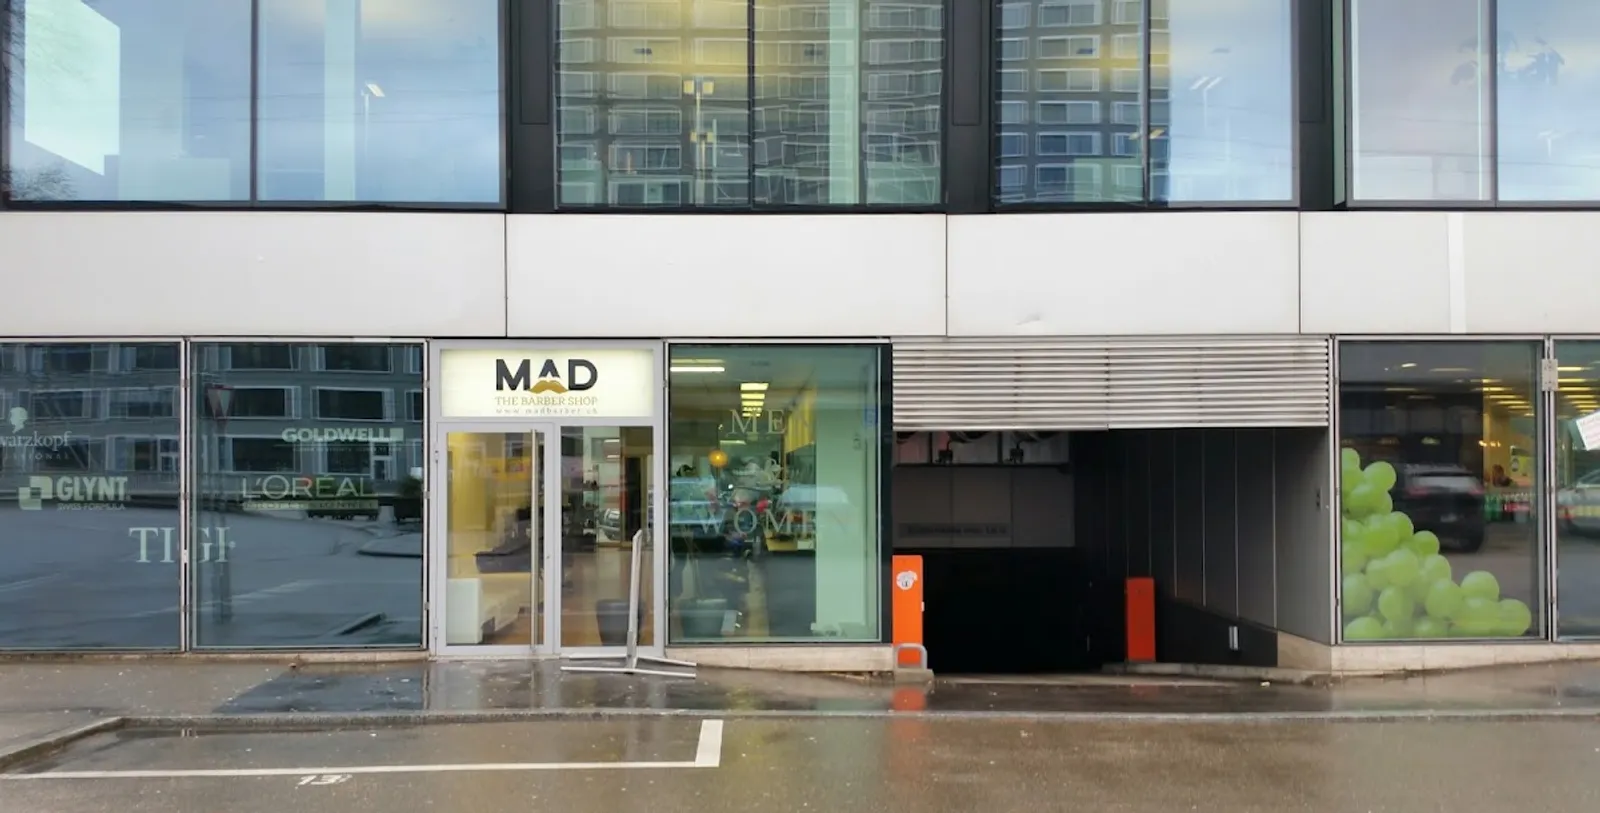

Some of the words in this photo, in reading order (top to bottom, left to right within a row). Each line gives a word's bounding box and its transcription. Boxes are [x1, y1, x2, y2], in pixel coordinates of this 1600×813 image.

[496, 359, 598, 394] MAD
[495, 396, 518, 406] THE
[521, 396, 565, 406] BARBER
[568, 396, 598, 406] SHOP
[282, 428, 390, 442] GOLDWELL
[56, 476, 128, 500] GLYNT
